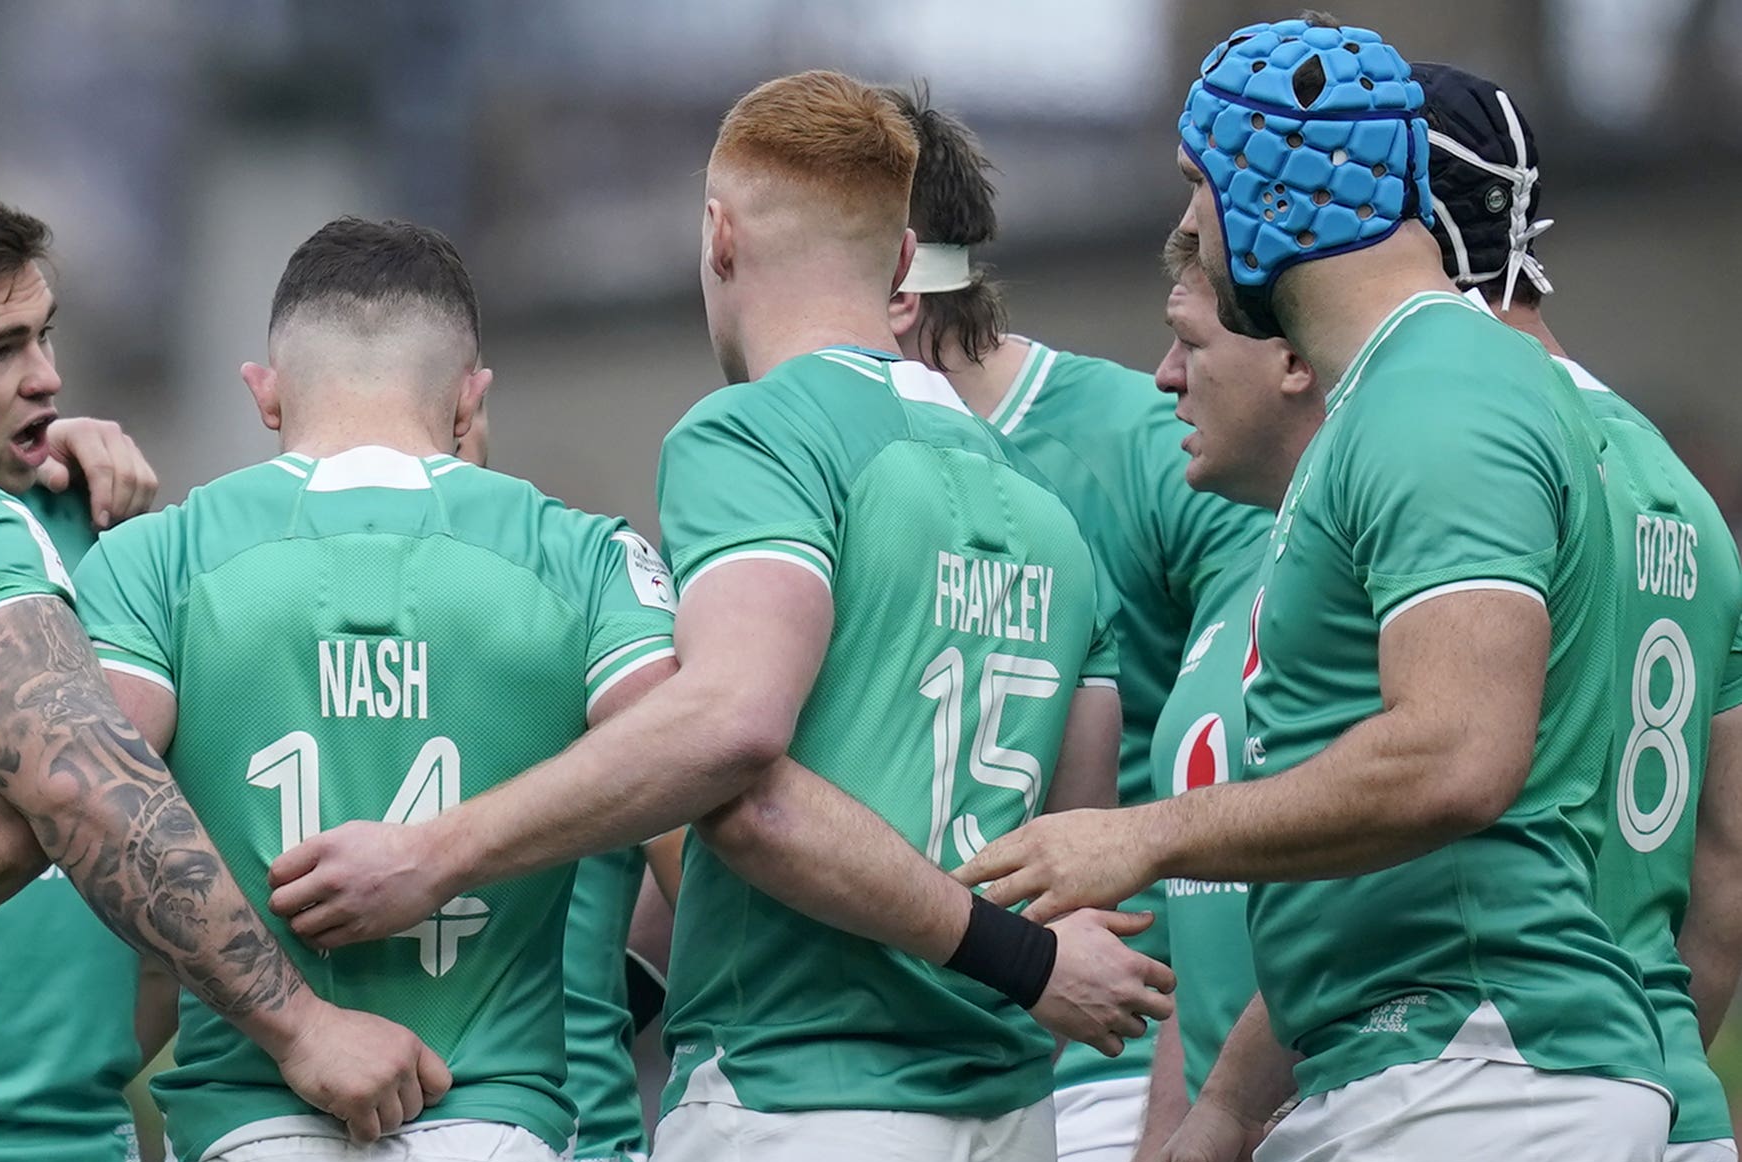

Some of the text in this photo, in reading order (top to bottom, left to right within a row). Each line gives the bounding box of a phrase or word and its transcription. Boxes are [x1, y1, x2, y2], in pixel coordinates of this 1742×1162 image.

[934, 550, 1054, 643] FRAWLEY
[1635, 513, 1698, 601] DORIS
[318, 639, 428, 720] NASH
[1616, 617, 1697, 853] 8
[918, 646, 1061, 888] 15
[245, 730, 493, 979] 14
